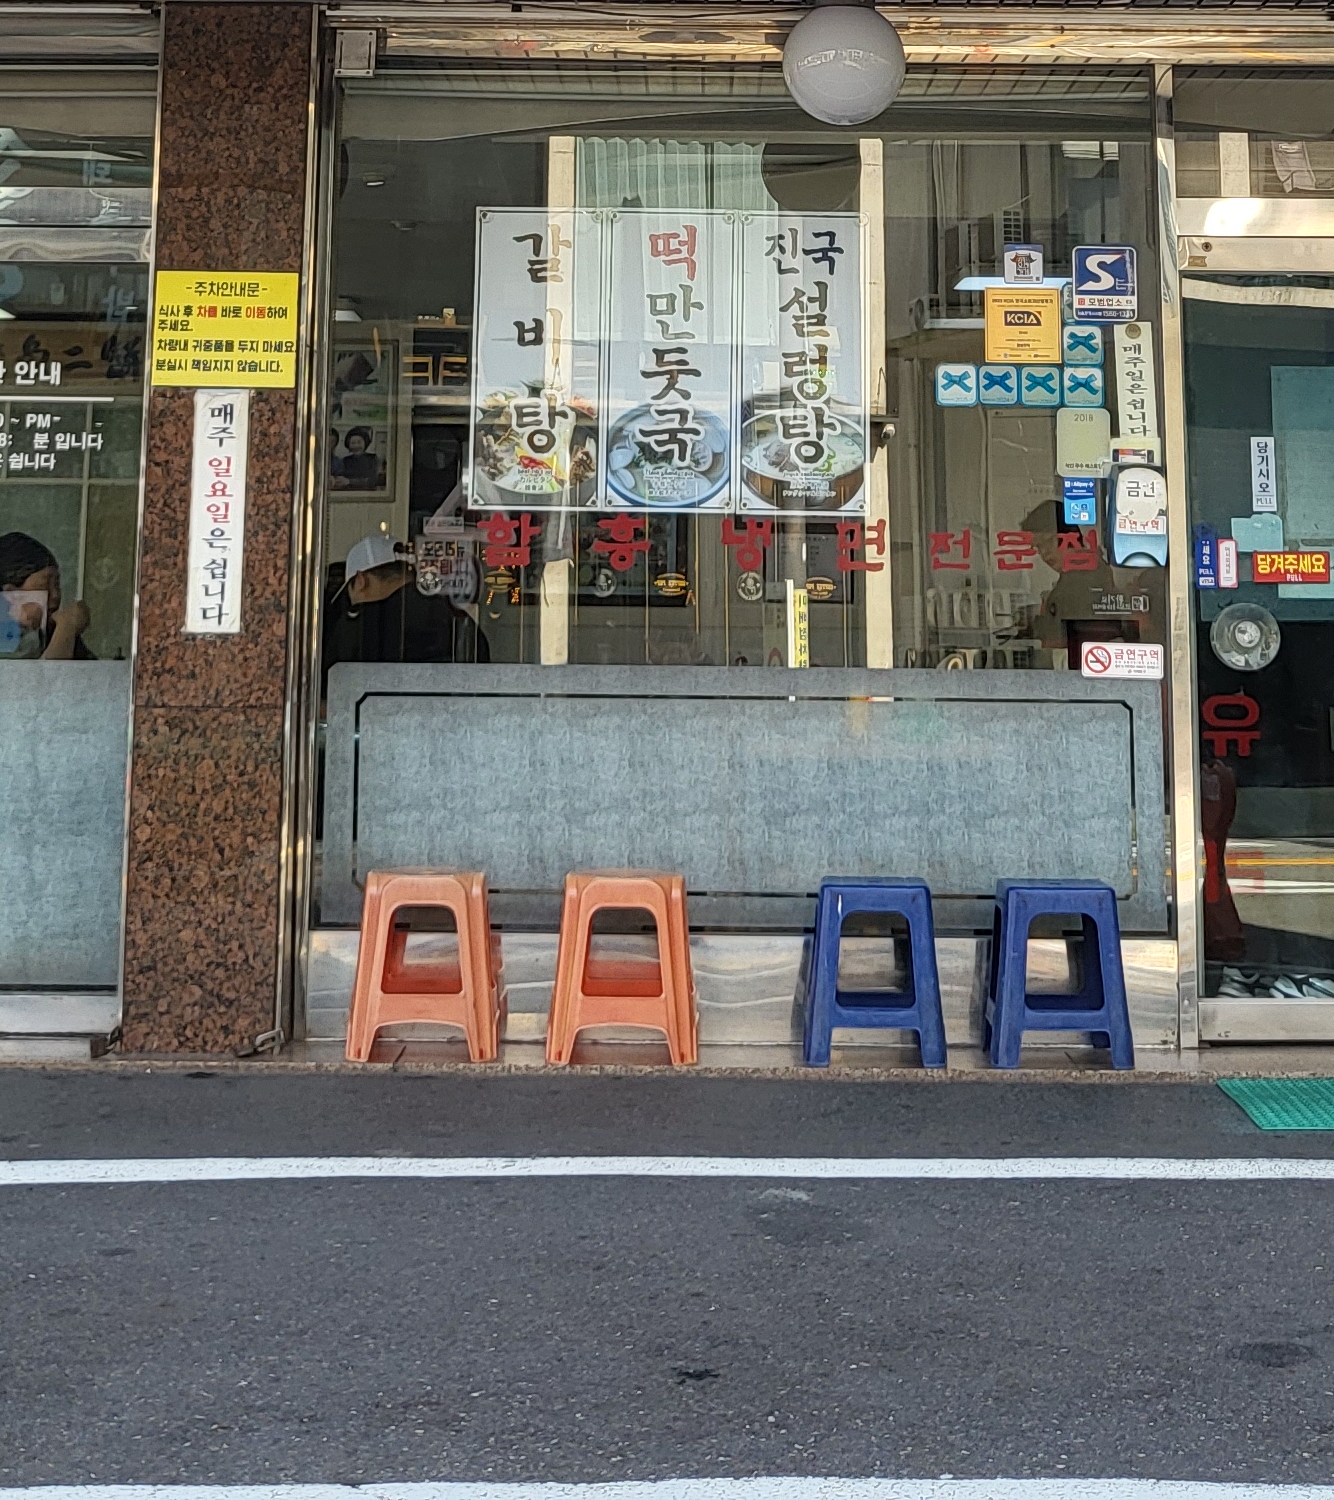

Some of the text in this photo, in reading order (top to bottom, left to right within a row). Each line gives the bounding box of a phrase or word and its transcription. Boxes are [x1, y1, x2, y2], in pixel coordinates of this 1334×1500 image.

[763, 226, 846, 277] 진국
[159, 305, 288, 319] 식사 후 차를 바로 이동하여
[1006, 313, 1038, 324] KCIA
[157, 319, 194, 332] 주세요.
[157, 338, 189, 352] 차량내
[237, 340, 259, 353] 두지
[508, 222, 578, 457] 갈비탕
[14, 360, 63, 386] 안내
[155, 358, 284, 373] 분실시 책임지지 않습니다.
[774, 281, 840, 466] 설렁탕
[25, 414, 52, 429] PM
[1074, 413, 1094, 422] 2018
[32, 432, 51, 450] 분
[54, 432, 105, 451] 입니다
[8, 452, 58, 471] 쉽니다
[1256, 441, 1271, 493] 당기시오
[1125, 480, 1156, 498] 금연
[199, 402, 237, 627] 매주 일요일은 쉽니다
[927, 528, 1098, 573] 전문점
[1257, 554, 1326, 575] 당겨주세요
[1114, 648, 1159, 662] 금연구역
